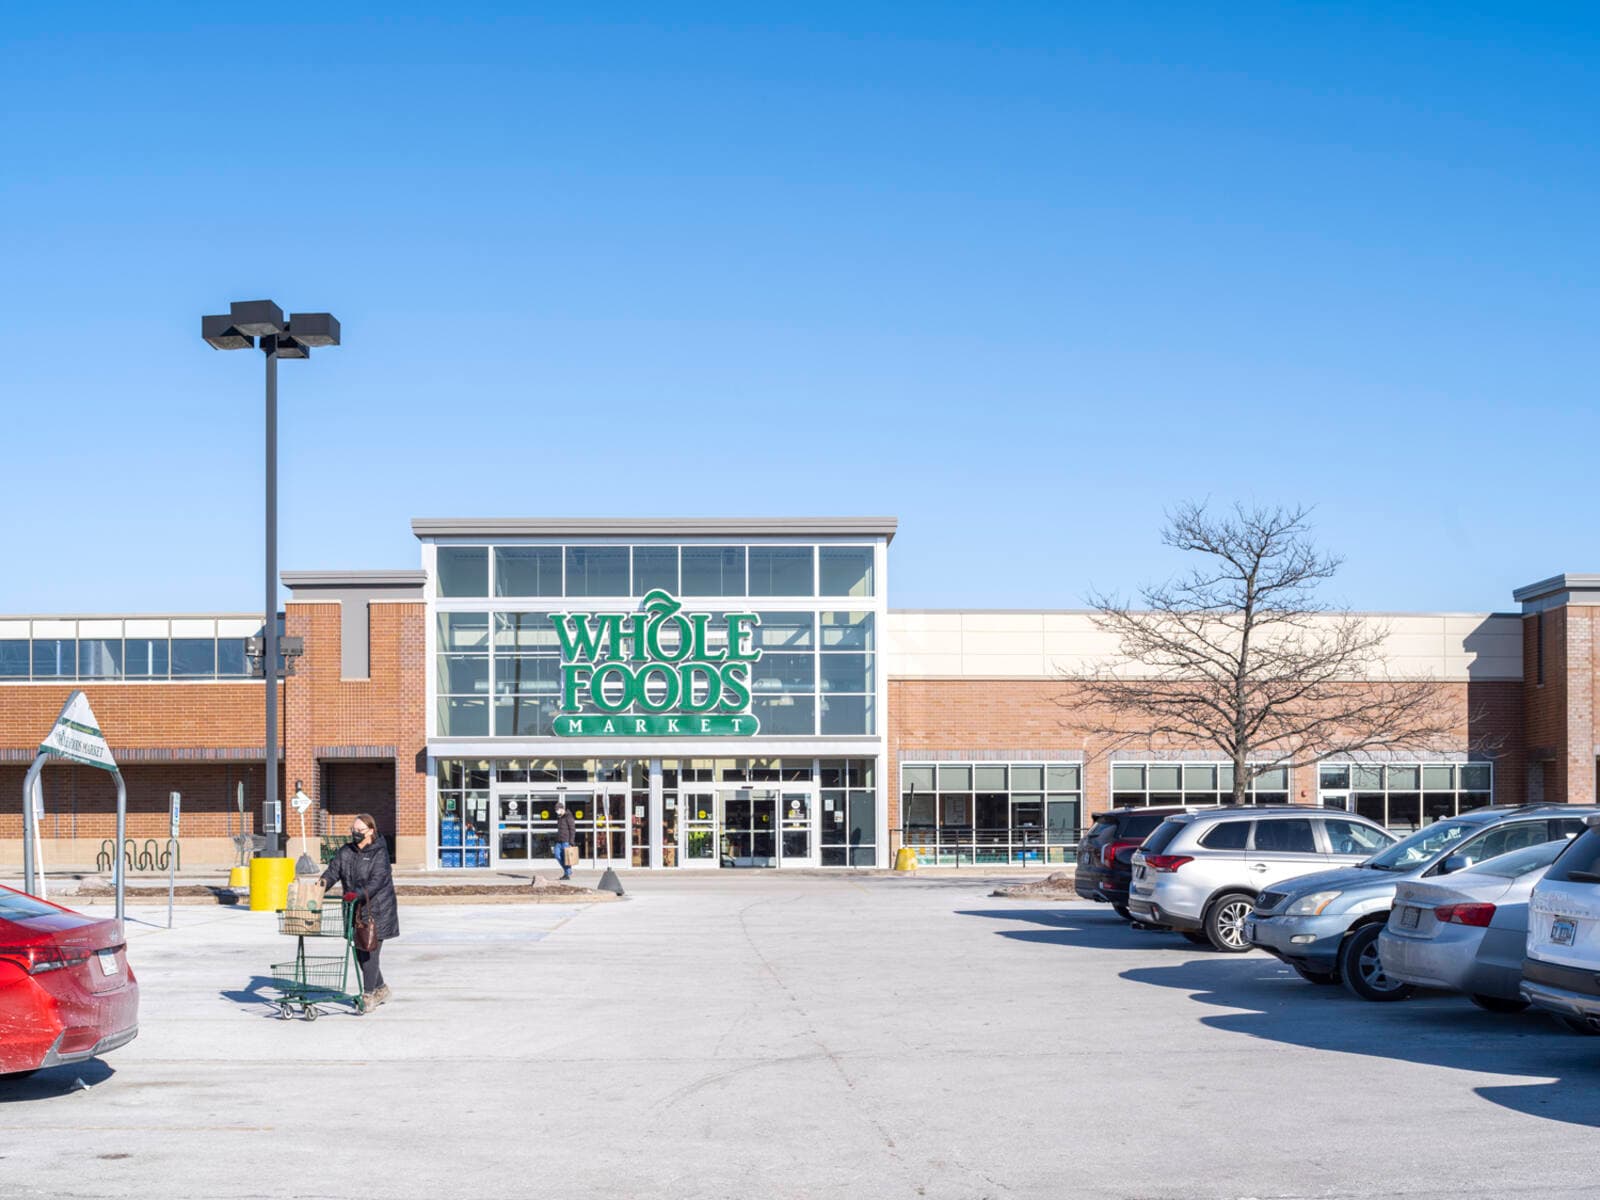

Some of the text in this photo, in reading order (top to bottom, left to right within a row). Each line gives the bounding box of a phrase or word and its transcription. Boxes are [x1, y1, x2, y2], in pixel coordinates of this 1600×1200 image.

[547, 610, 761, 662] WHOLE
[560, 662, 752, 713] FOODS
[569, 718, 743, 733] MARKET
